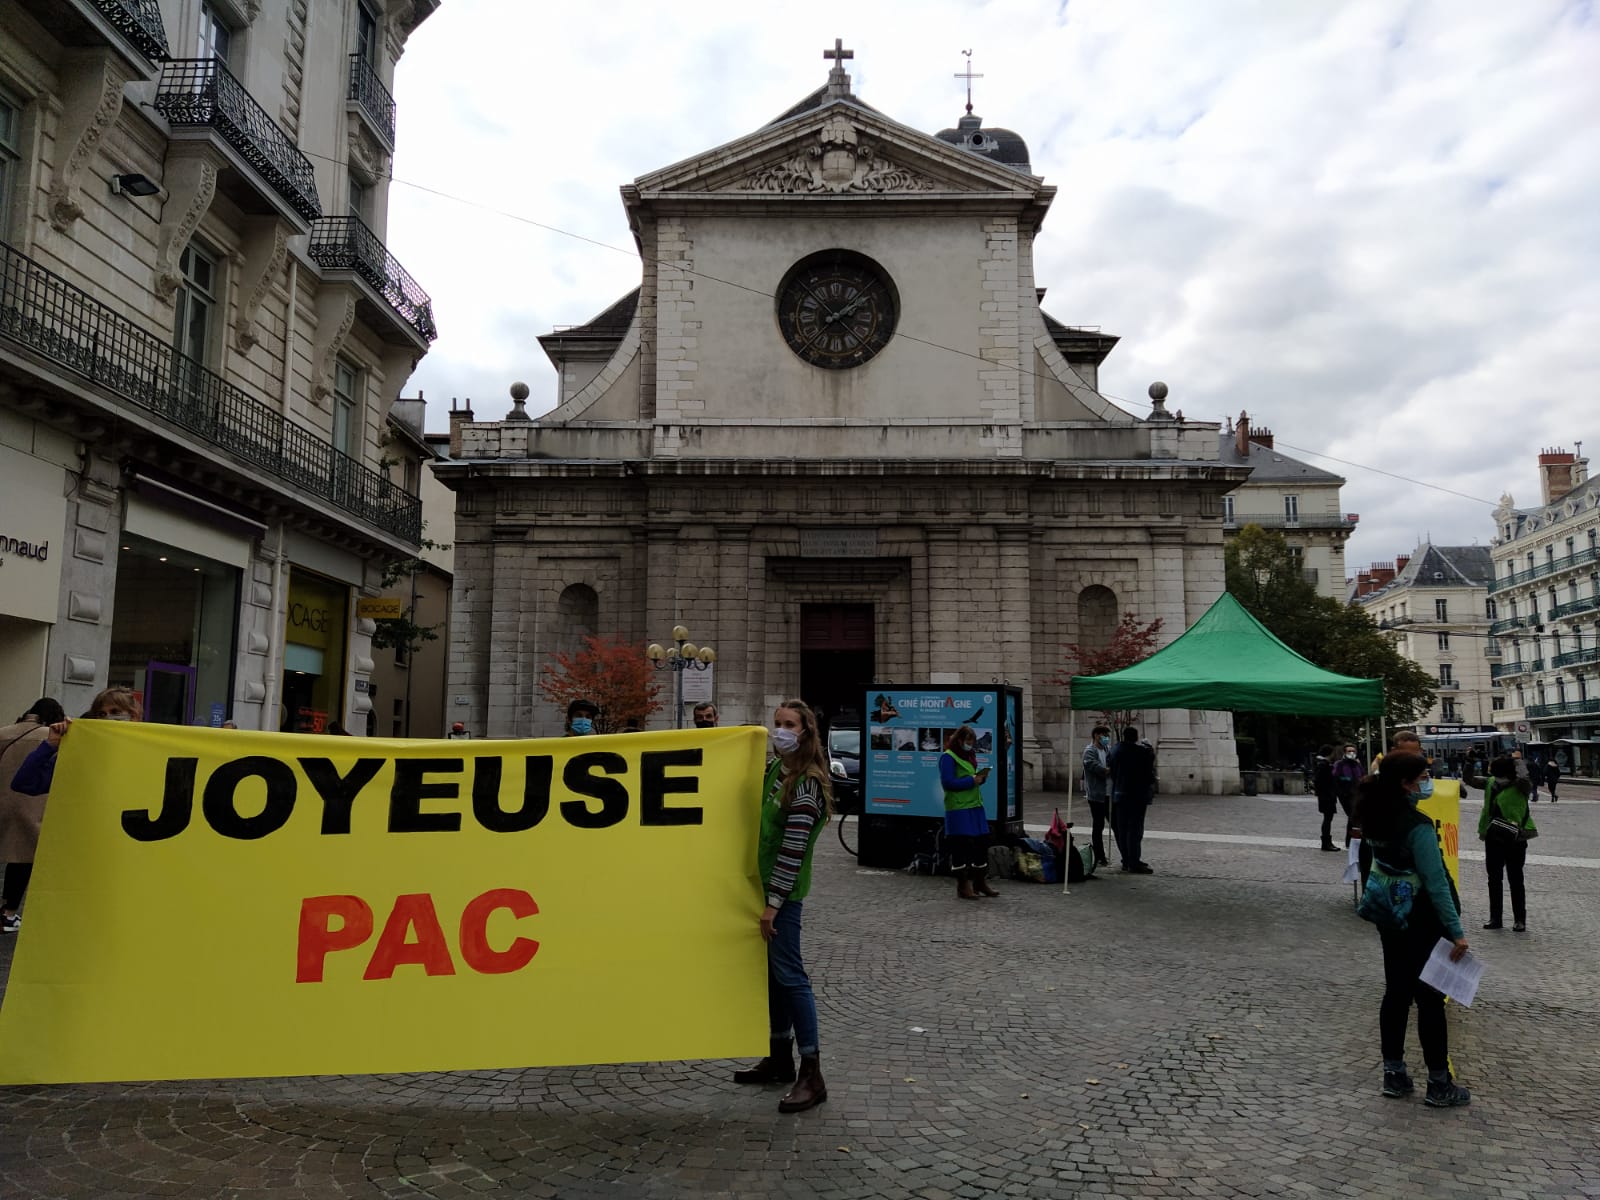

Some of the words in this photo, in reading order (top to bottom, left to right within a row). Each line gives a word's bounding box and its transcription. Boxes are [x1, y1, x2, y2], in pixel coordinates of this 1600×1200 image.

[920, 695, 972, 709] MONTAGNE
[121, 748, 703, 840] JOYEUSE
[295, 887, 540, 983] PAC
